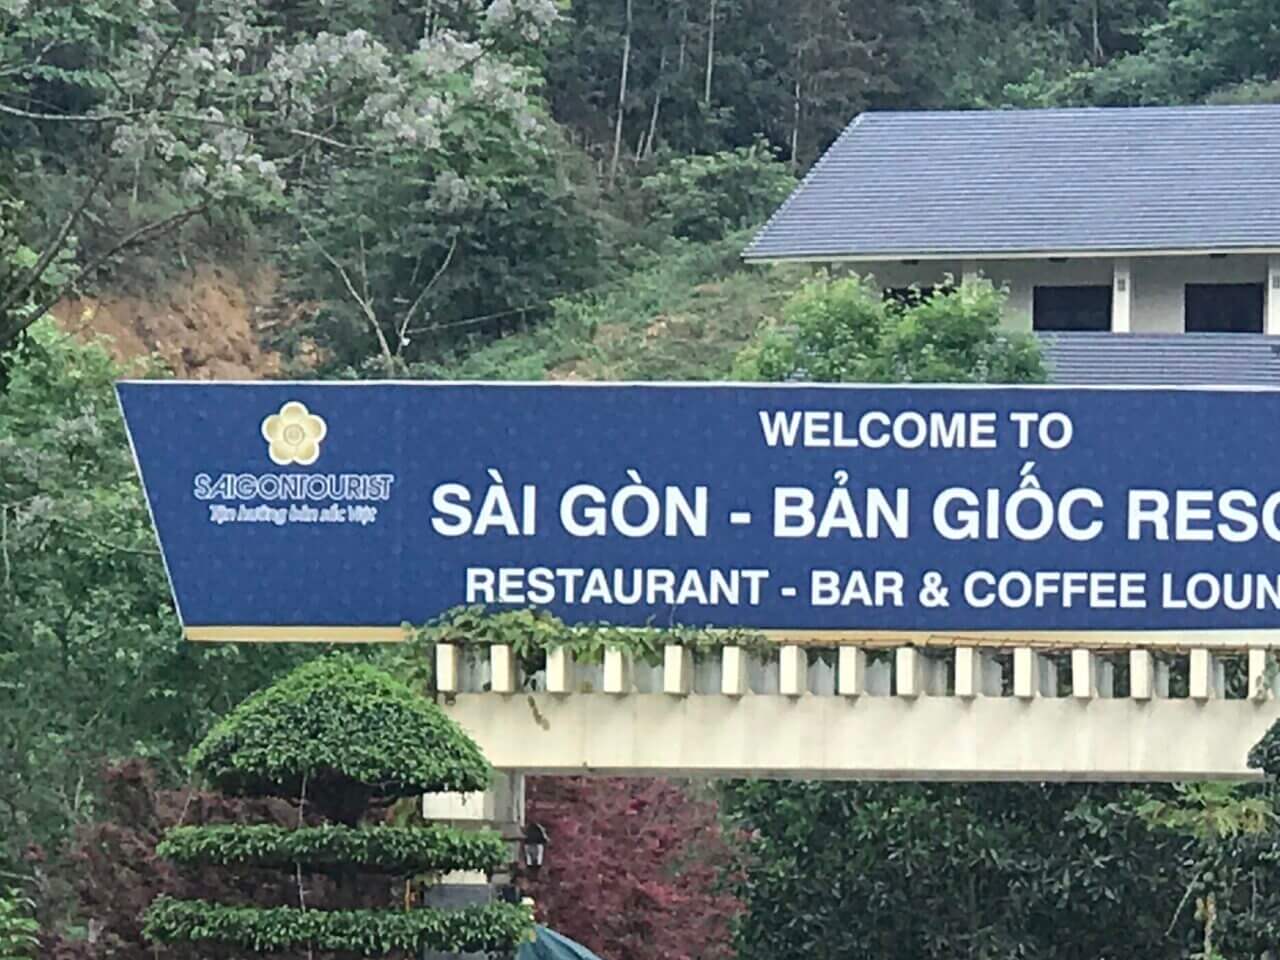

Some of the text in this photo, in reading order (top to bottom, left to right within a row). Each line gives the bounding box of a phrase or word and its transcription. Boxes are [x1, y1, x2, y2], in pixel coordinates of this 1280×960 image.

[759, 411, 1073, 449] WELCOME TO
[194, 473, 394, 500] SAIGONTOURIST
[431, 468, 536, 537] SÀI
[559, 469, 708, 538] GÒN
[730, 511, 751, 524] -
[773, 470, 909, 539] BẢN
[932, 461, 1104, 541] GIỐC
[465, 567, 769, 605] RESTAURANT
[781, 587, 797, 597] -
[811, 570, 904, 607] BAR
[918, 571, 950, 608] &
[963, 571, 1147, 609] COFFEE
